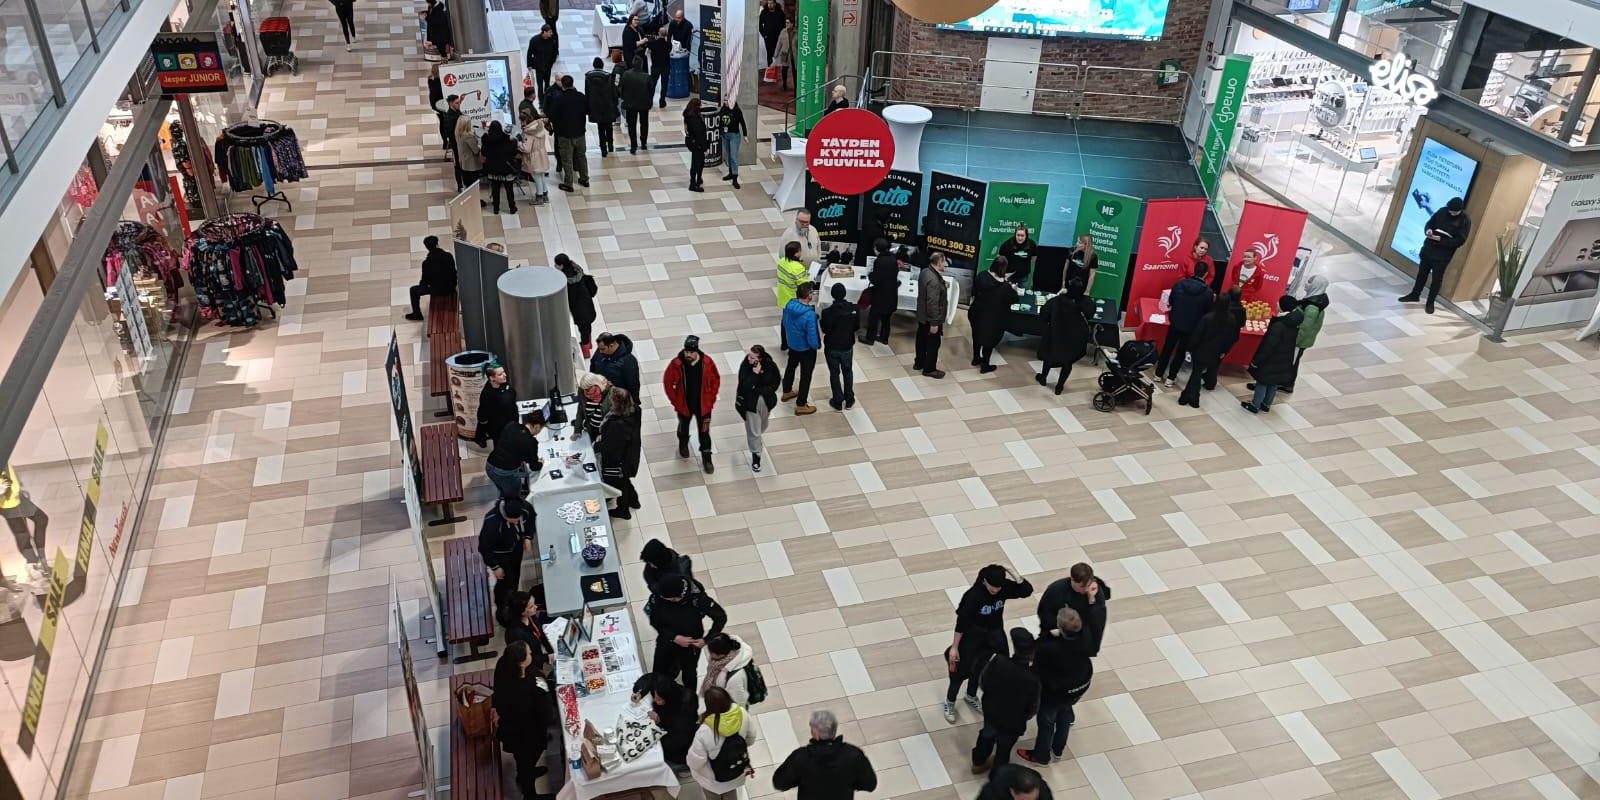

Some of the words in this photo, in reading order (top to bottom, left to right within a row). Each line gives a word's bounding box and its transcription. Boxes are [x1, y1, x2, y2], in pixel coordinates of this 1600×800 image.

[189, 73, 221, 83] JUNIOR
[457, 71, 486, 80] APUTEAM
[1369, 52, 1438, 105] elisa
[821, 138, 880, 148] TÄYDEN
[820, 149, 880, 158] KYMPIN
[813, 158, 885, 168] PUUVILLA
[1564, 173, 1595, 182] SAMSUNG
[936, 183, 980, 199] SATAKUNNAN
[1570, 199, 1595, 207] Galaxy
[1102, 205, 1115, 216] ME
[944, 219, 963, 228] TAKSI
[1091, 221, 1119, 233] Yhdessä
[1089, 229, 1118, 240] teemme
[927, 235, 947, 247] 0600
[948, 240, 964, 250] 300
[965, 244, 976, 254] 33
[91, 439, 105, 486] SALE
[77, 514, 94, 574] FINAL
[46, 571, 64, 627] SALE
[23, 665, 47, 737] FINAL
